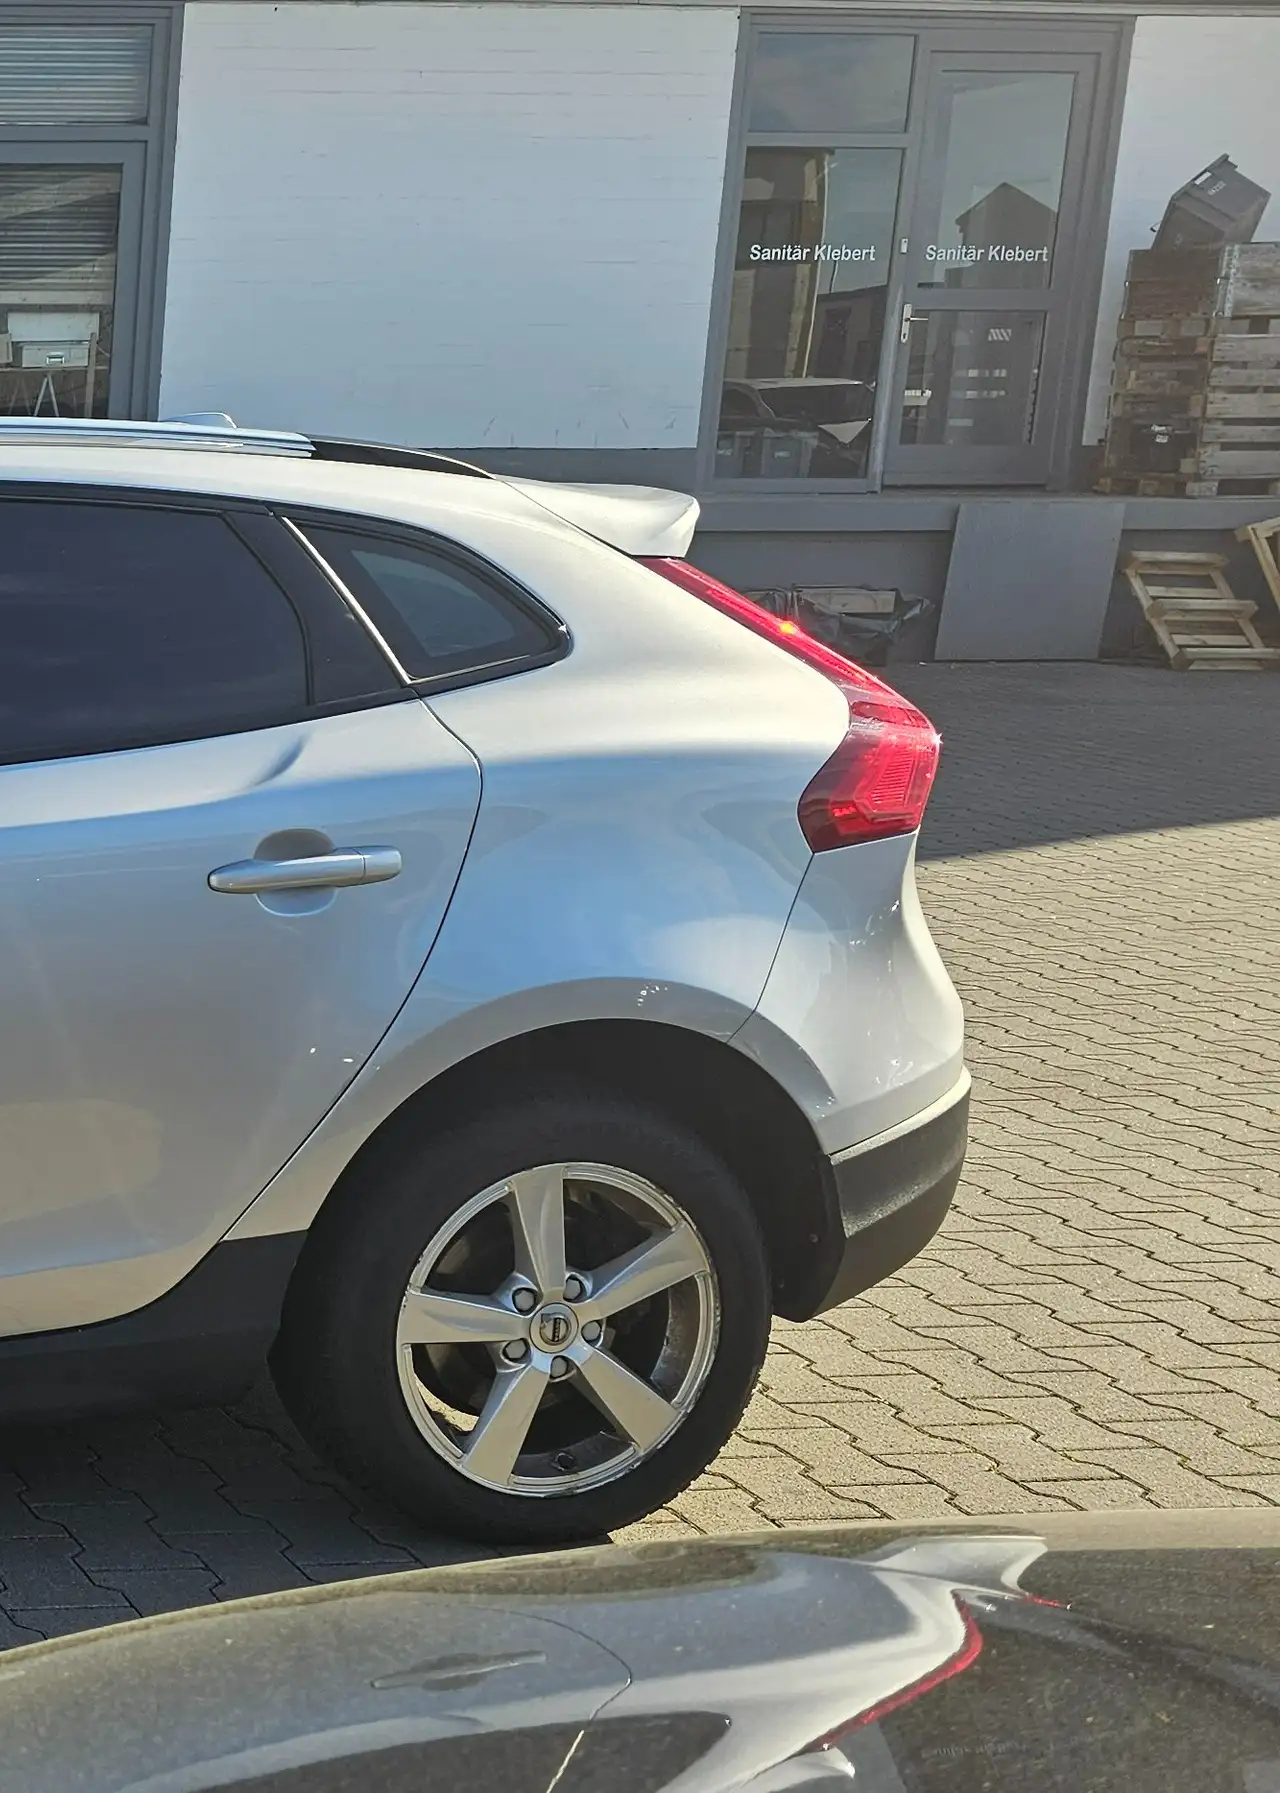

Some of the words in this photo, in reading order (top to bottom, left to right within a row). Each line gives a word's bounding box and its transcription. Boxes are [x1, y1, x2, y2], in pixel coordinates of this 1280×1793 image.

[749, 243, 811, 261] Sanitär
[814, 244, 876, 261] Klebert
[925, 244, 985, 261] Sanitär
[988, 245, 1049, 262] Klebert
